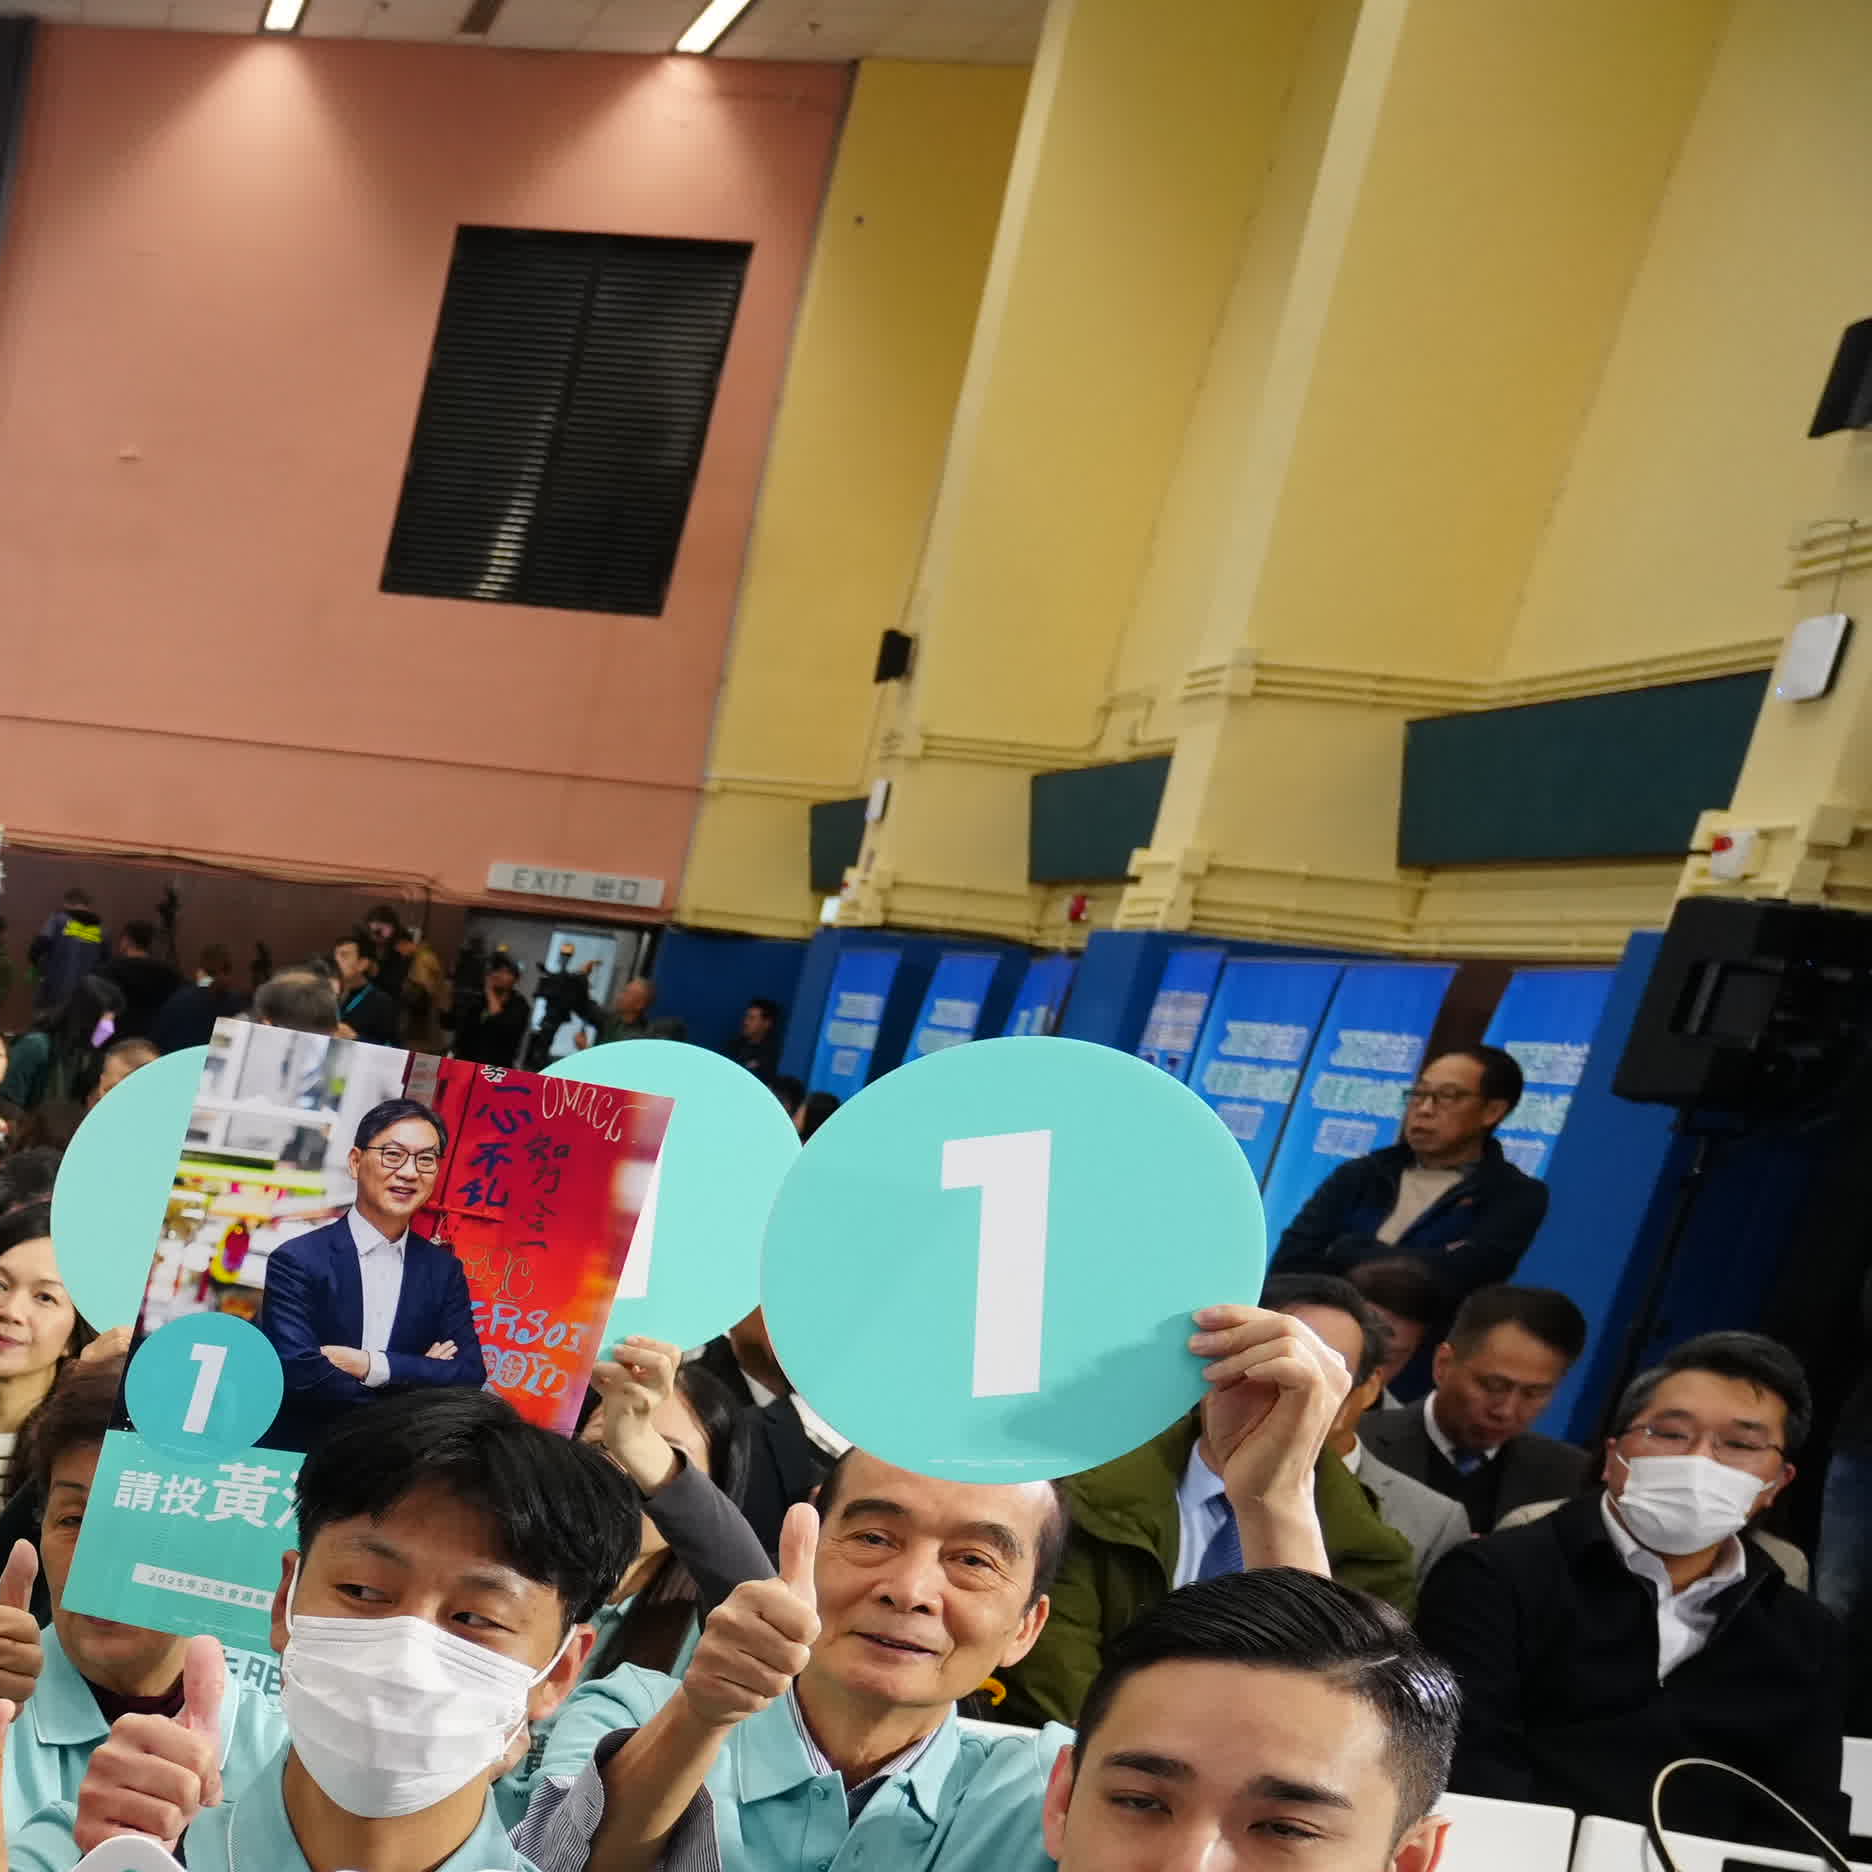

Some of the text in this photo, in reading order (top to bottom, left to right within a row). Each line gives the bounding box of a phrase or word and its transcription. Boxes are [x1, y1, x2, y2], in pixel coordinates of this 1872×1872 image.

[511, 867, 641, 903] EXIT 出口
[940, 1128, 1052, 1399] 1
[182, 1343, 228, 1434] 1
